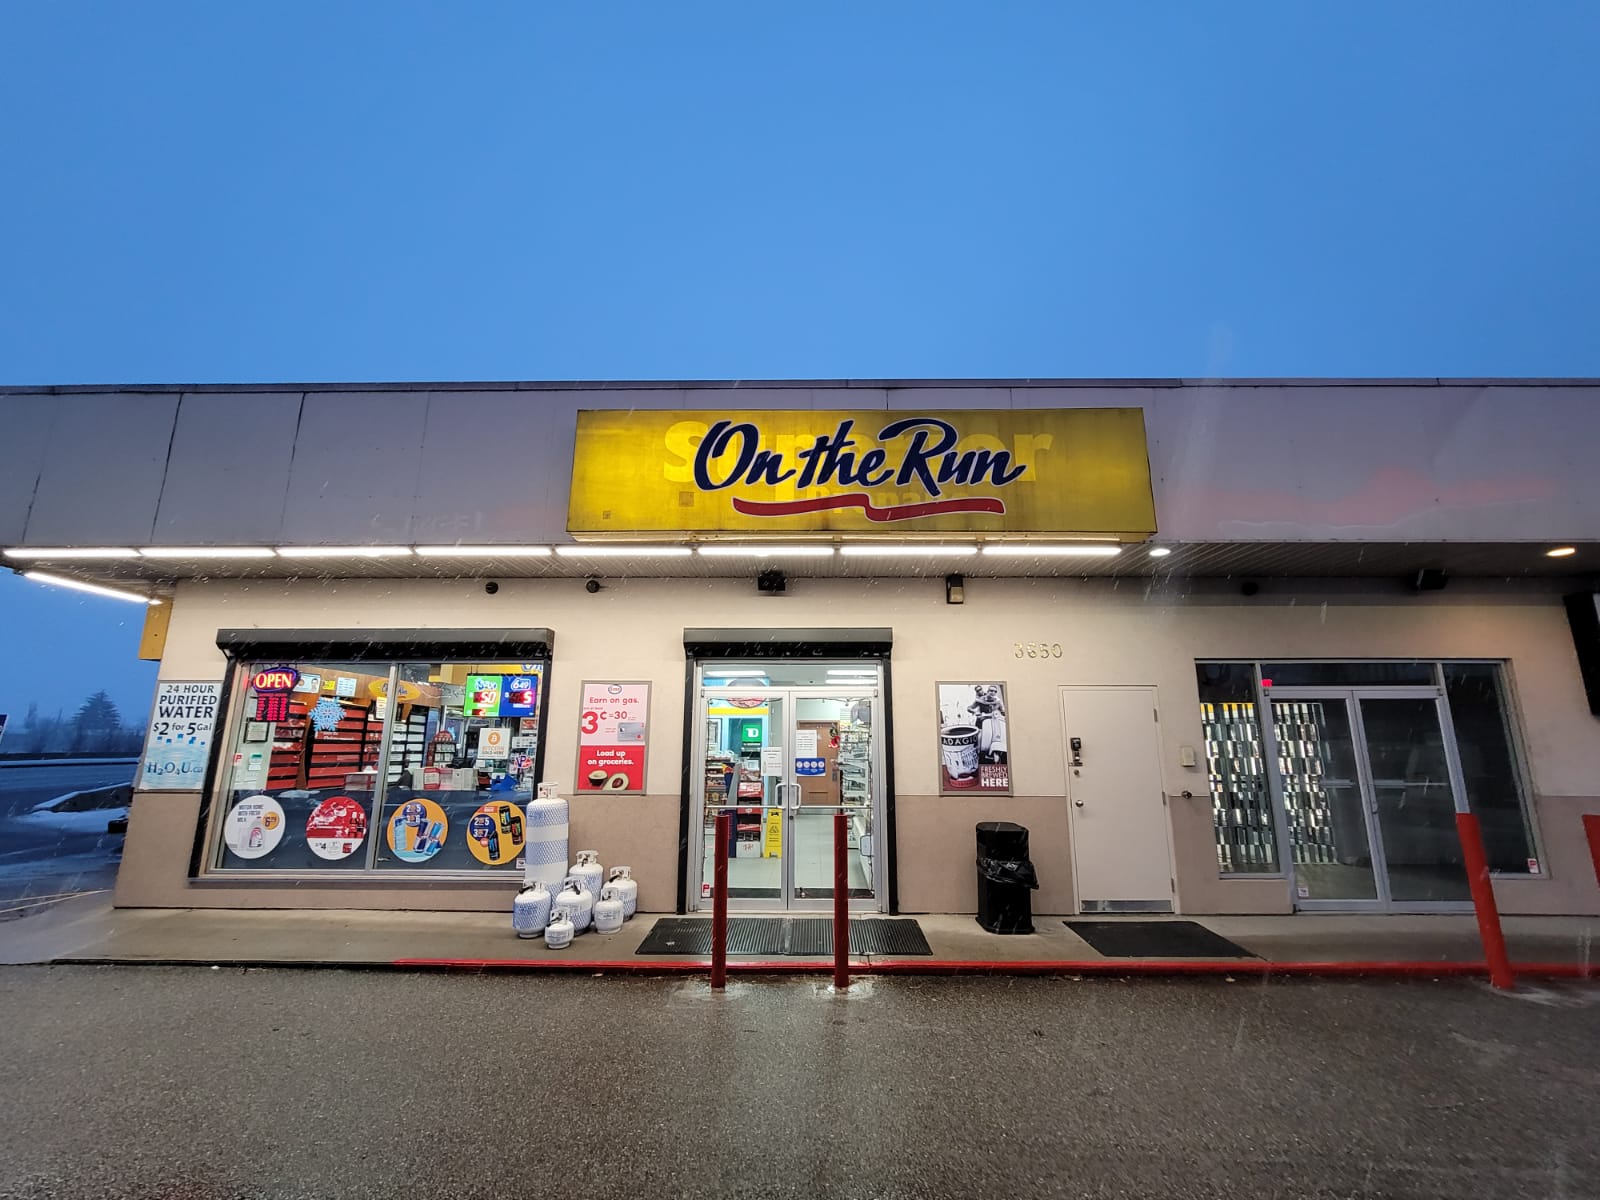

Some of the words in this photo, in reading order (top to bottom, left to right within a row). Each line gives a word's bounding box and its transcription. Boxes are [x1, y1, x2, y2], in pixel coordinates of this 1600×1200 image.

[693, 419, 796, 491] On
[798, 419, 896, 489] the
[878, 417, 1027, 498] Run
[1013, 643, 1063, 659] 3650
[254, 673, 293, 689] OPEN
[166, 684, 180, 693] 24
[183, 684, 215, 693] HOUR
[159, 695, 218, 705] PURIFIED
[622, 697, 640, 706] gas.
[158, 706, 214, 719] WATER
[153, 722, 170, 735] $2
[171, 722, 185, 731] for
[745, 727, 759, 738] TD
[616, 751, 626, 760] up
[598, 758, 634, 767] groceries.
[981, 778, 1009, 787] HERE
